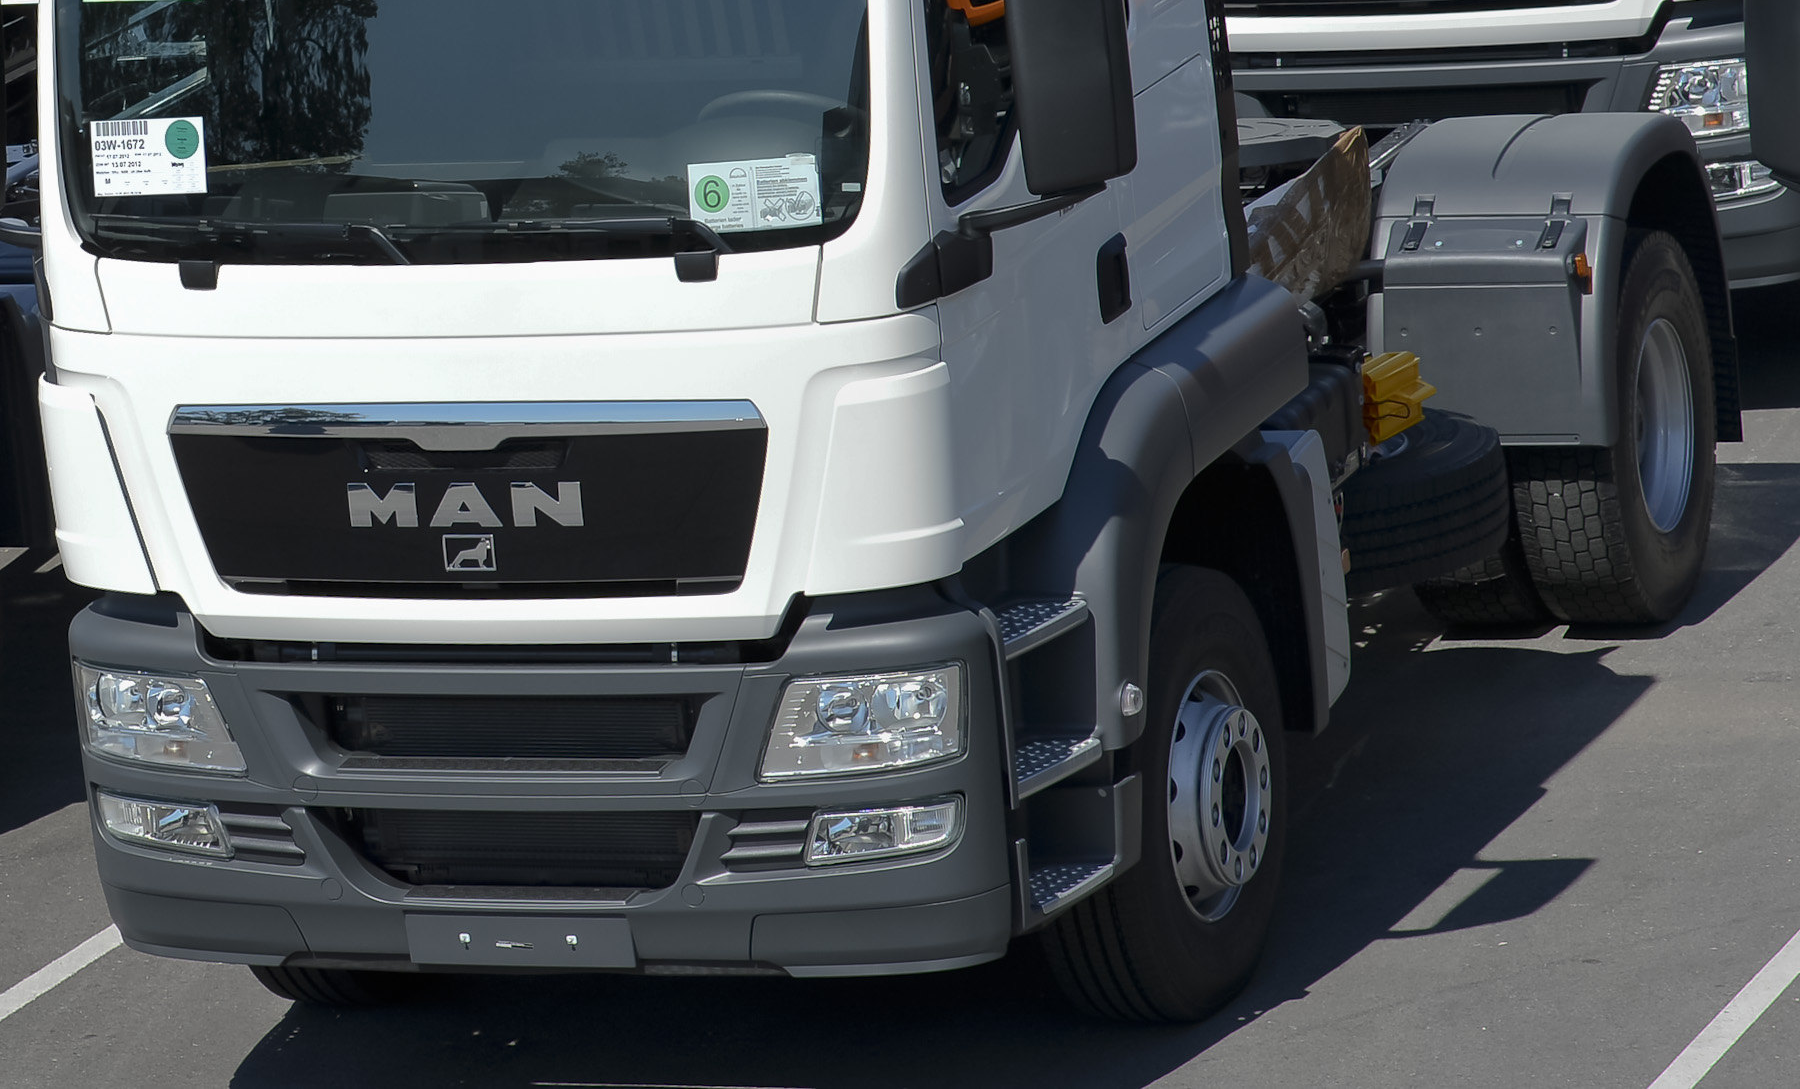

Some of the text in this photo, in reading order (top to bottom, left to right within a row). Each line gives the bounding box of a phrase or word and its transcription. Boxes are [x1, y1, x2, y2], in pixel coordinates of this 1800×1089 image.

[94, 138, 145, 151] 03W-1672
[703, 180, 720, 208] 6
[347, 481, 585, 528] MAN
